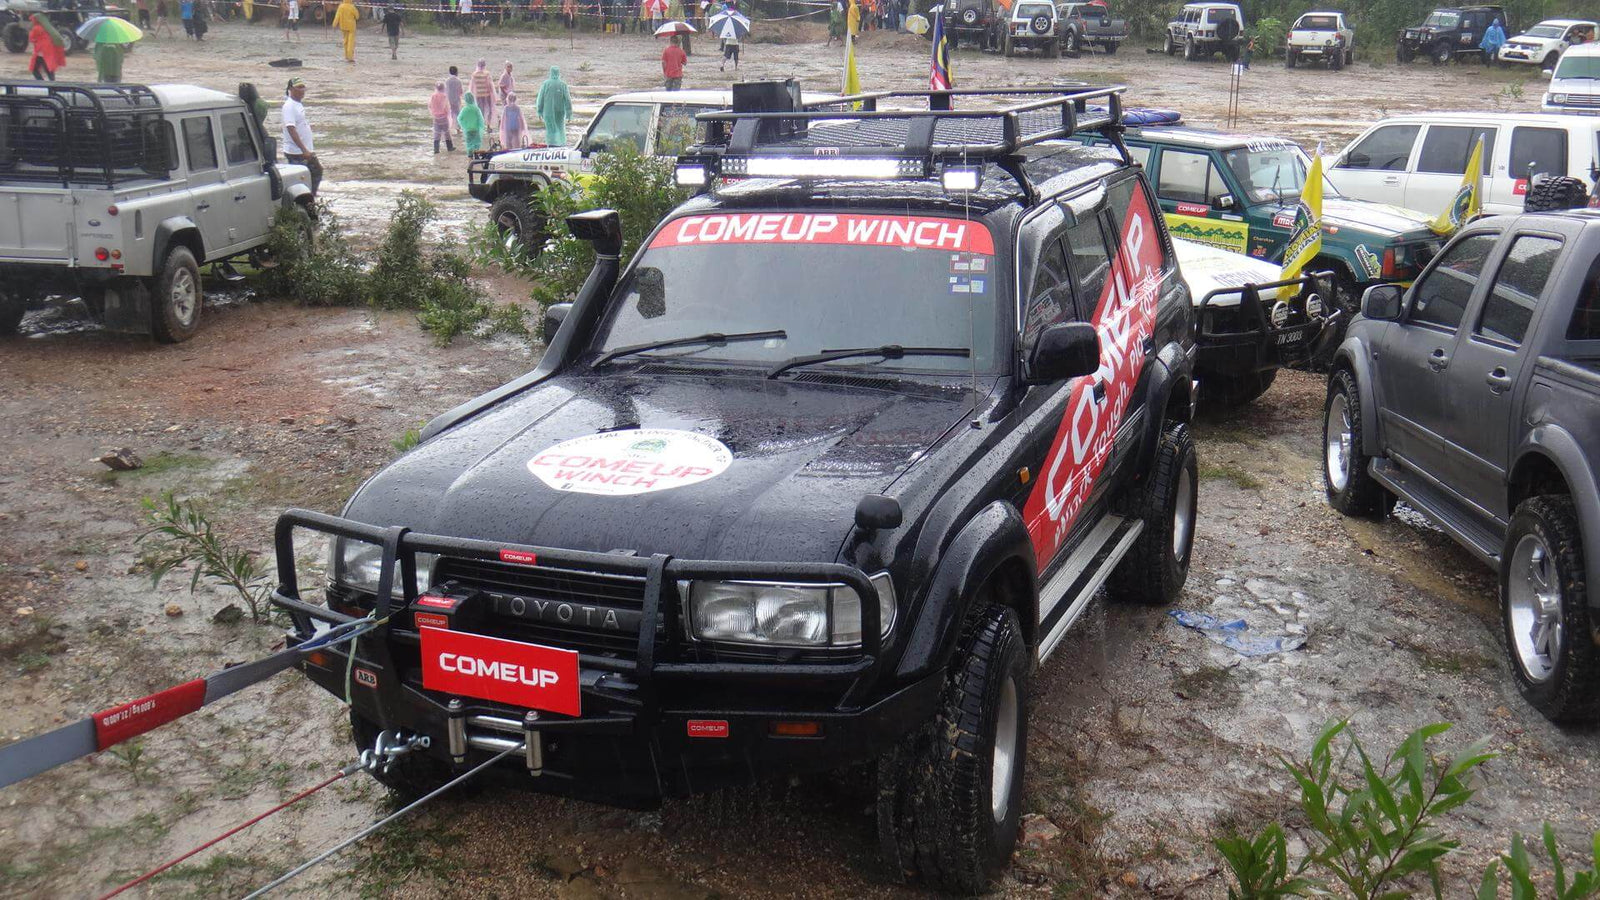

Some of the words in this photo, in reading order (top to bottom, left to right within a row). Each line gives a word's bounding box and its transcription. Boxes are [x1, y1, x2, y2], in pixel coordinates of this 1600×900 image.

[1177, 205, 1208, 214] COMEUP
[676, 214, 839, 242] COMEUP
[847, 219, 966, 248] WINCH
[533, 454, 713, 479] COMEUP
[554, 469, 659, 488] WINCH
[503, 553, 533, 563] COMEUP
[490, 593, 620, 630] TOYOTA
[417, 617, 446, 626] COMEUP
[358, 671, 376, 685] ARB
[439, 652, 560, 688] COMEUP
